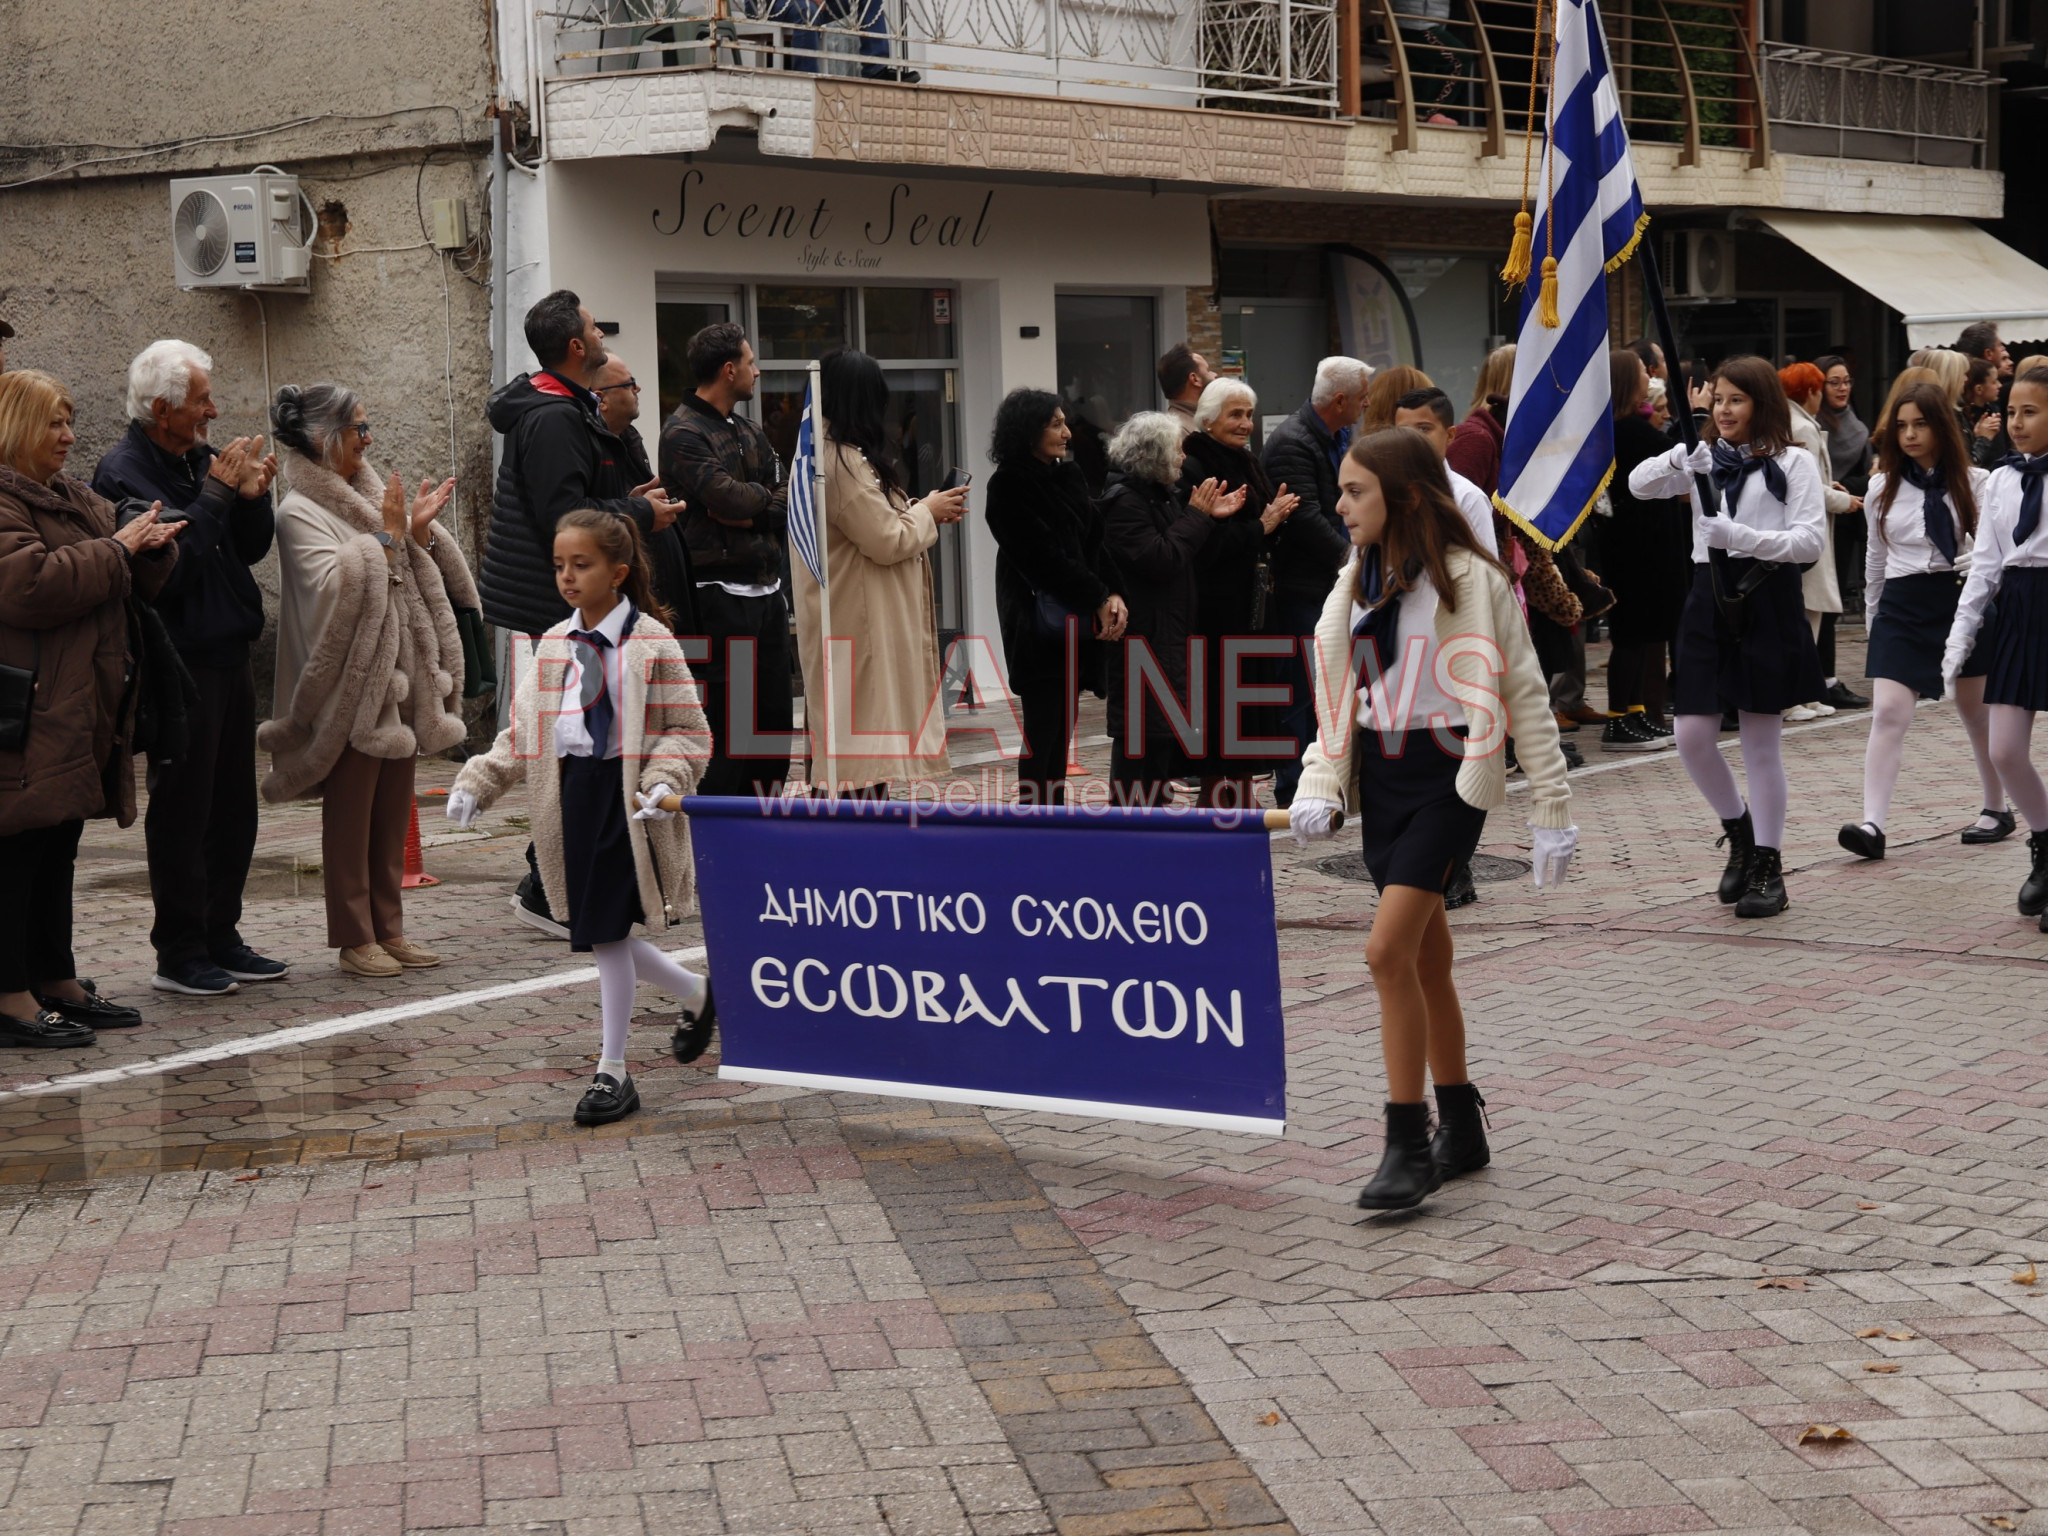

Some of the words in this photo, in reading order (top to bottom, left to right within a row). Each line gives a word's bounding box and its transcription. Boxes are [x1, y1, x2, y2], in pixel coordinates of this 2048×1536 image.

[652, 169, 833, 240] Scent
[864, 183, 995, 247] Seal
[797, 244, 830, 272] Style
[834, 250, 847, 267] &
[848, 248, 881, 268] Scent
[759, 883, 986, 934] ΔΗΜΟΤΙΚΟ
